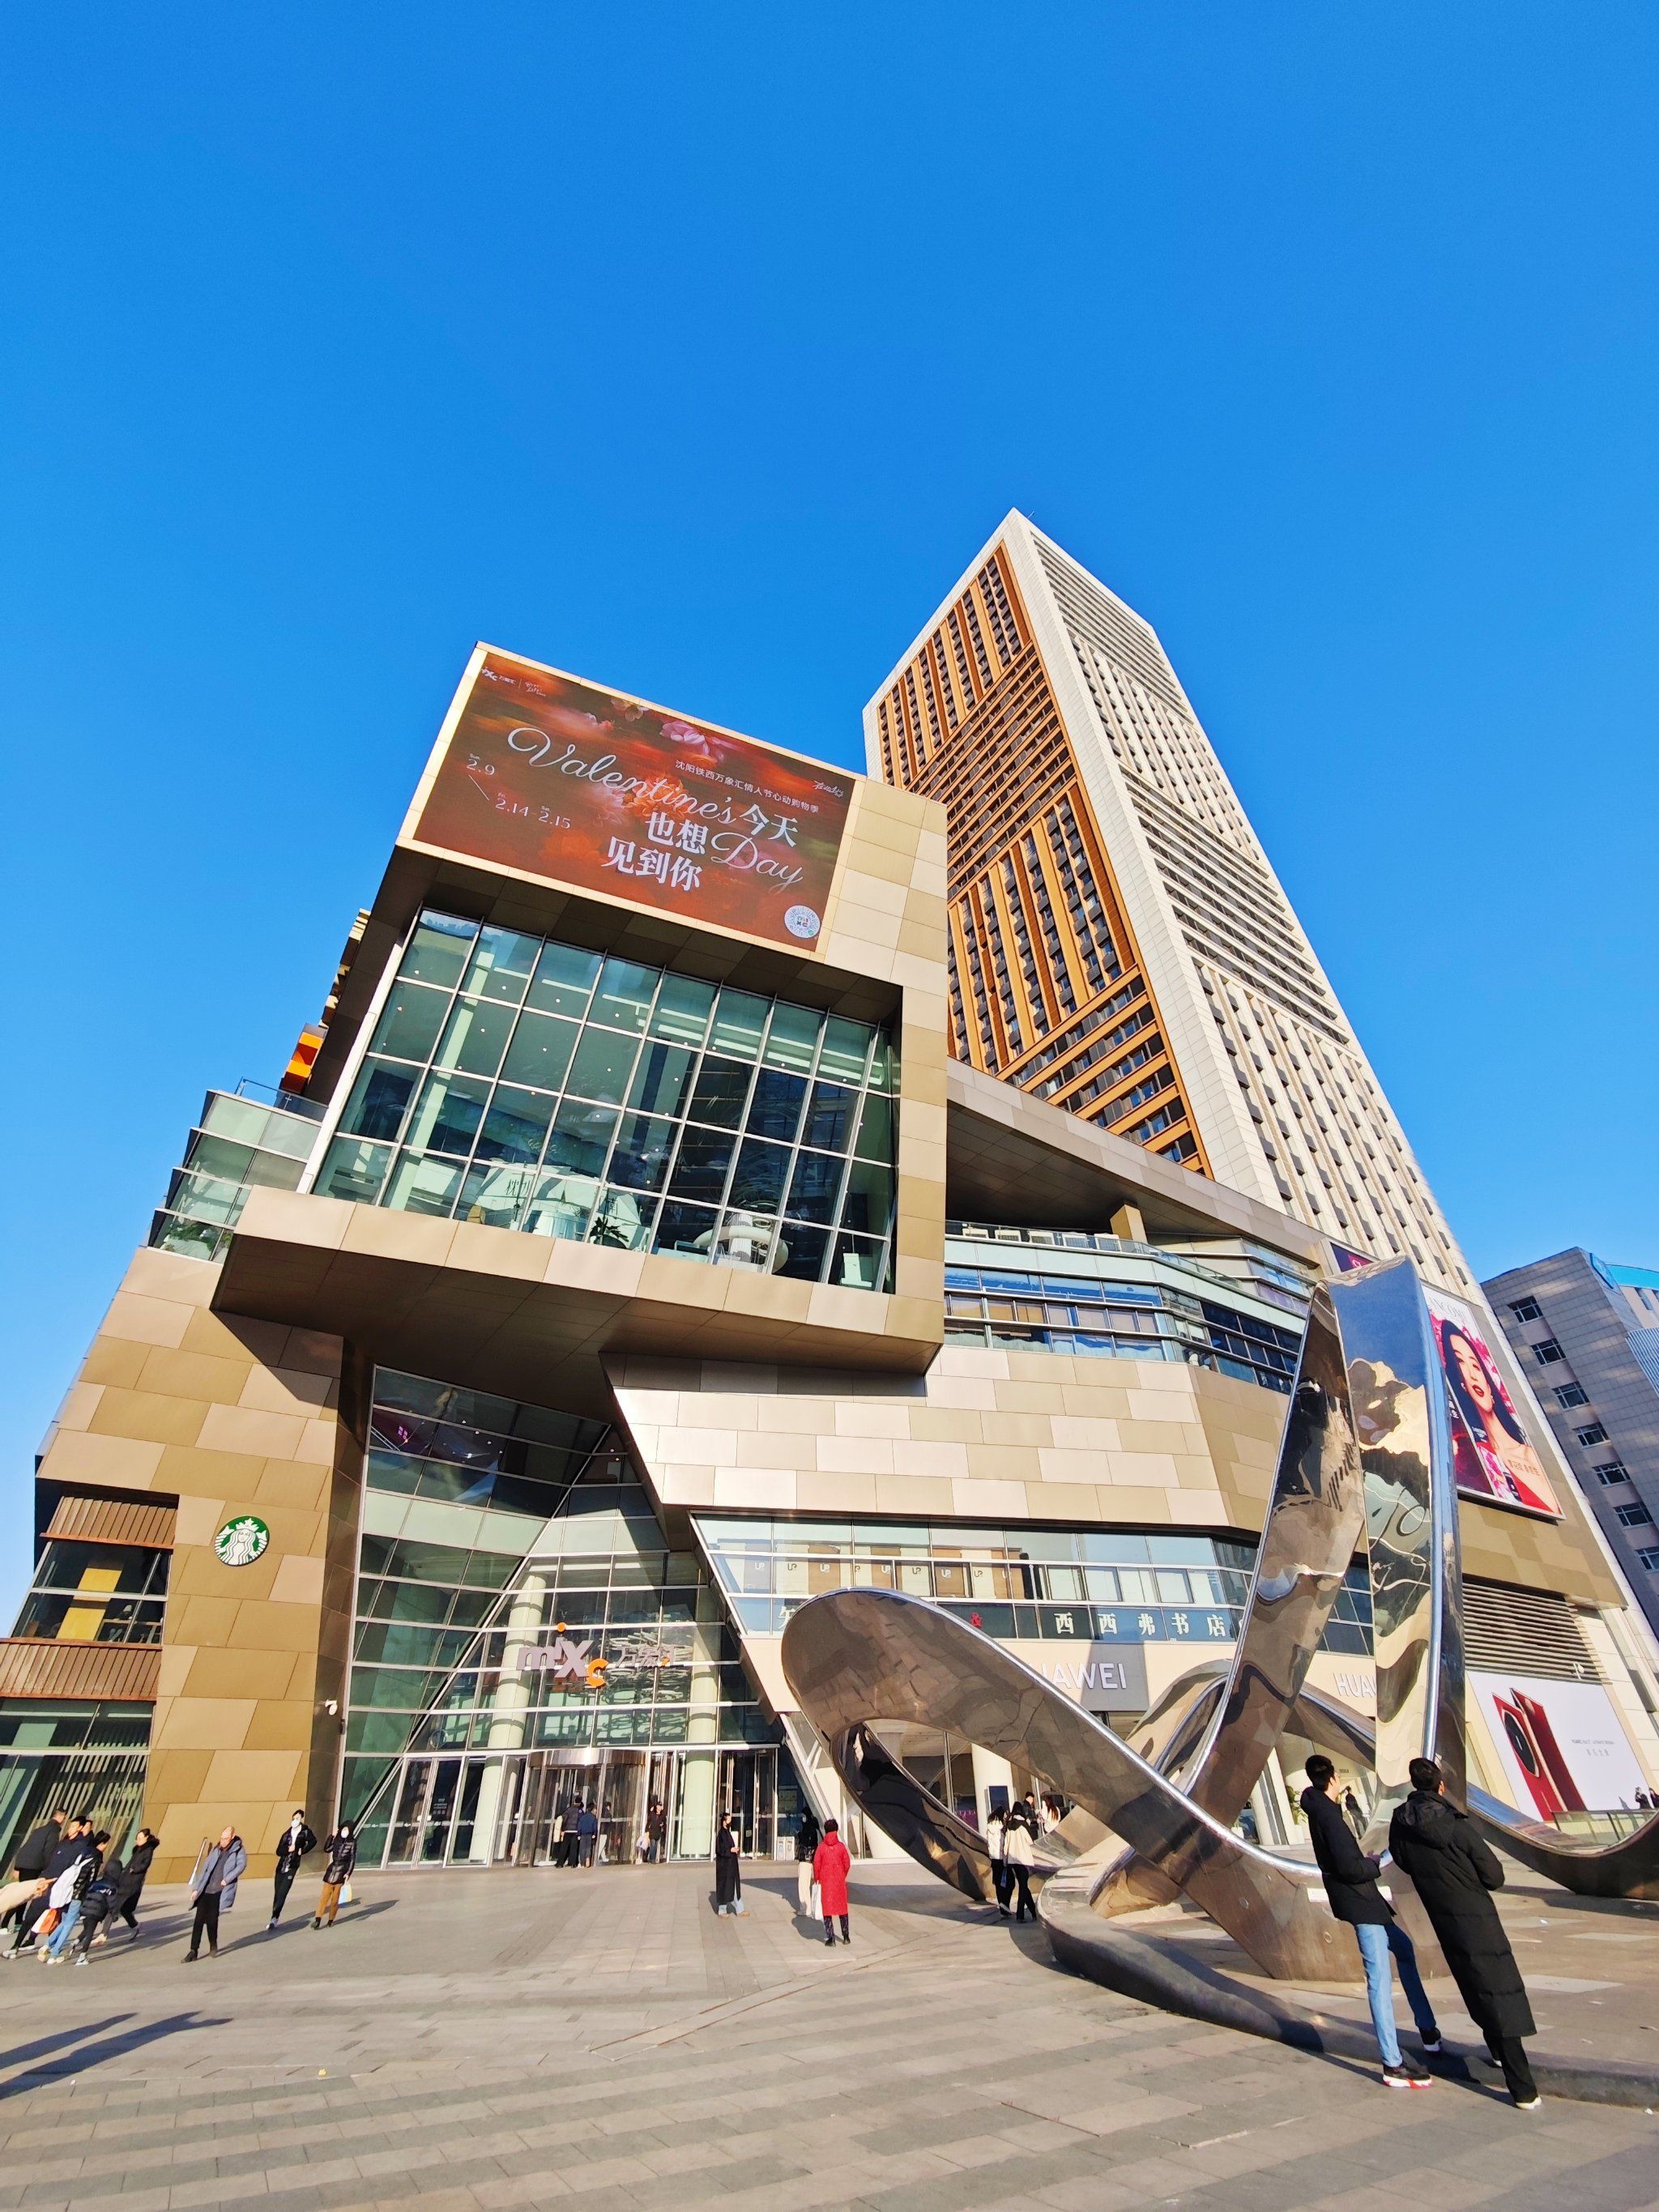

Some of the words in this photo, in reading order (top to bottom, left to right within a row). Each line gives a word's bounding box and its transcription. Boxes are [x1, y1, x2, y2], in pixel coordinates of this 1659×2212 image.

[467, 758, 495, 775] 2.9
[508, 727, 736, 824] Valentine's
[675, 760, 821, 813] 沈阳铁西万象汇情人节心动购物季
[646, 812, 709, 855] 也想
[740, 803, 799, 847] 今天
[601, 836, 702, 891] 见到你
[710, 832, 804, 894] Day
[1054, 1612, 1226, 1637] 西西弗书店
[1028, 1663, 1127, 1689] AWEI
[1333, 1672, 1375, 1698] HUA
